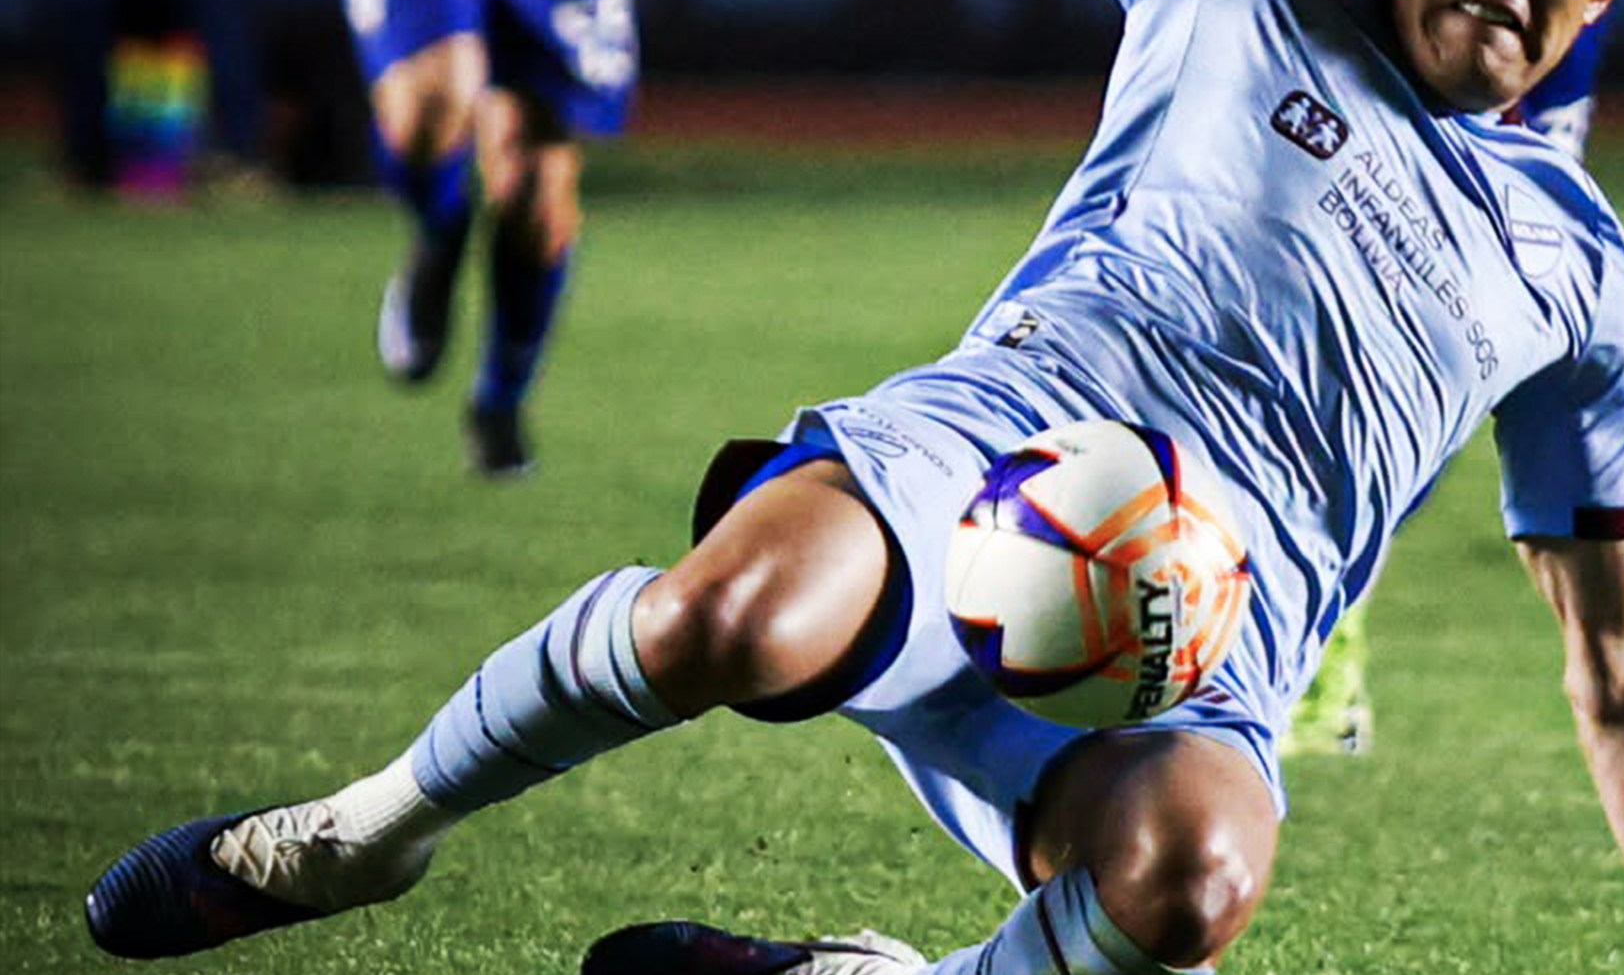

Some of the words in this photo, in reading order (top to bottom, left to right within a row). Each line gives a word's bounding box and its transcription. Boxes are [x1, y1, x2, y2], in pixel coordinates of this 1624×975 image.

[1317, 185, 1404, 293] BOLIVIA
[1354, 150, 1448, 253] ALDEAS
[1338, 168, 1468, 321] INFANTILES
[1465, 321, 1499, 381] SOS
